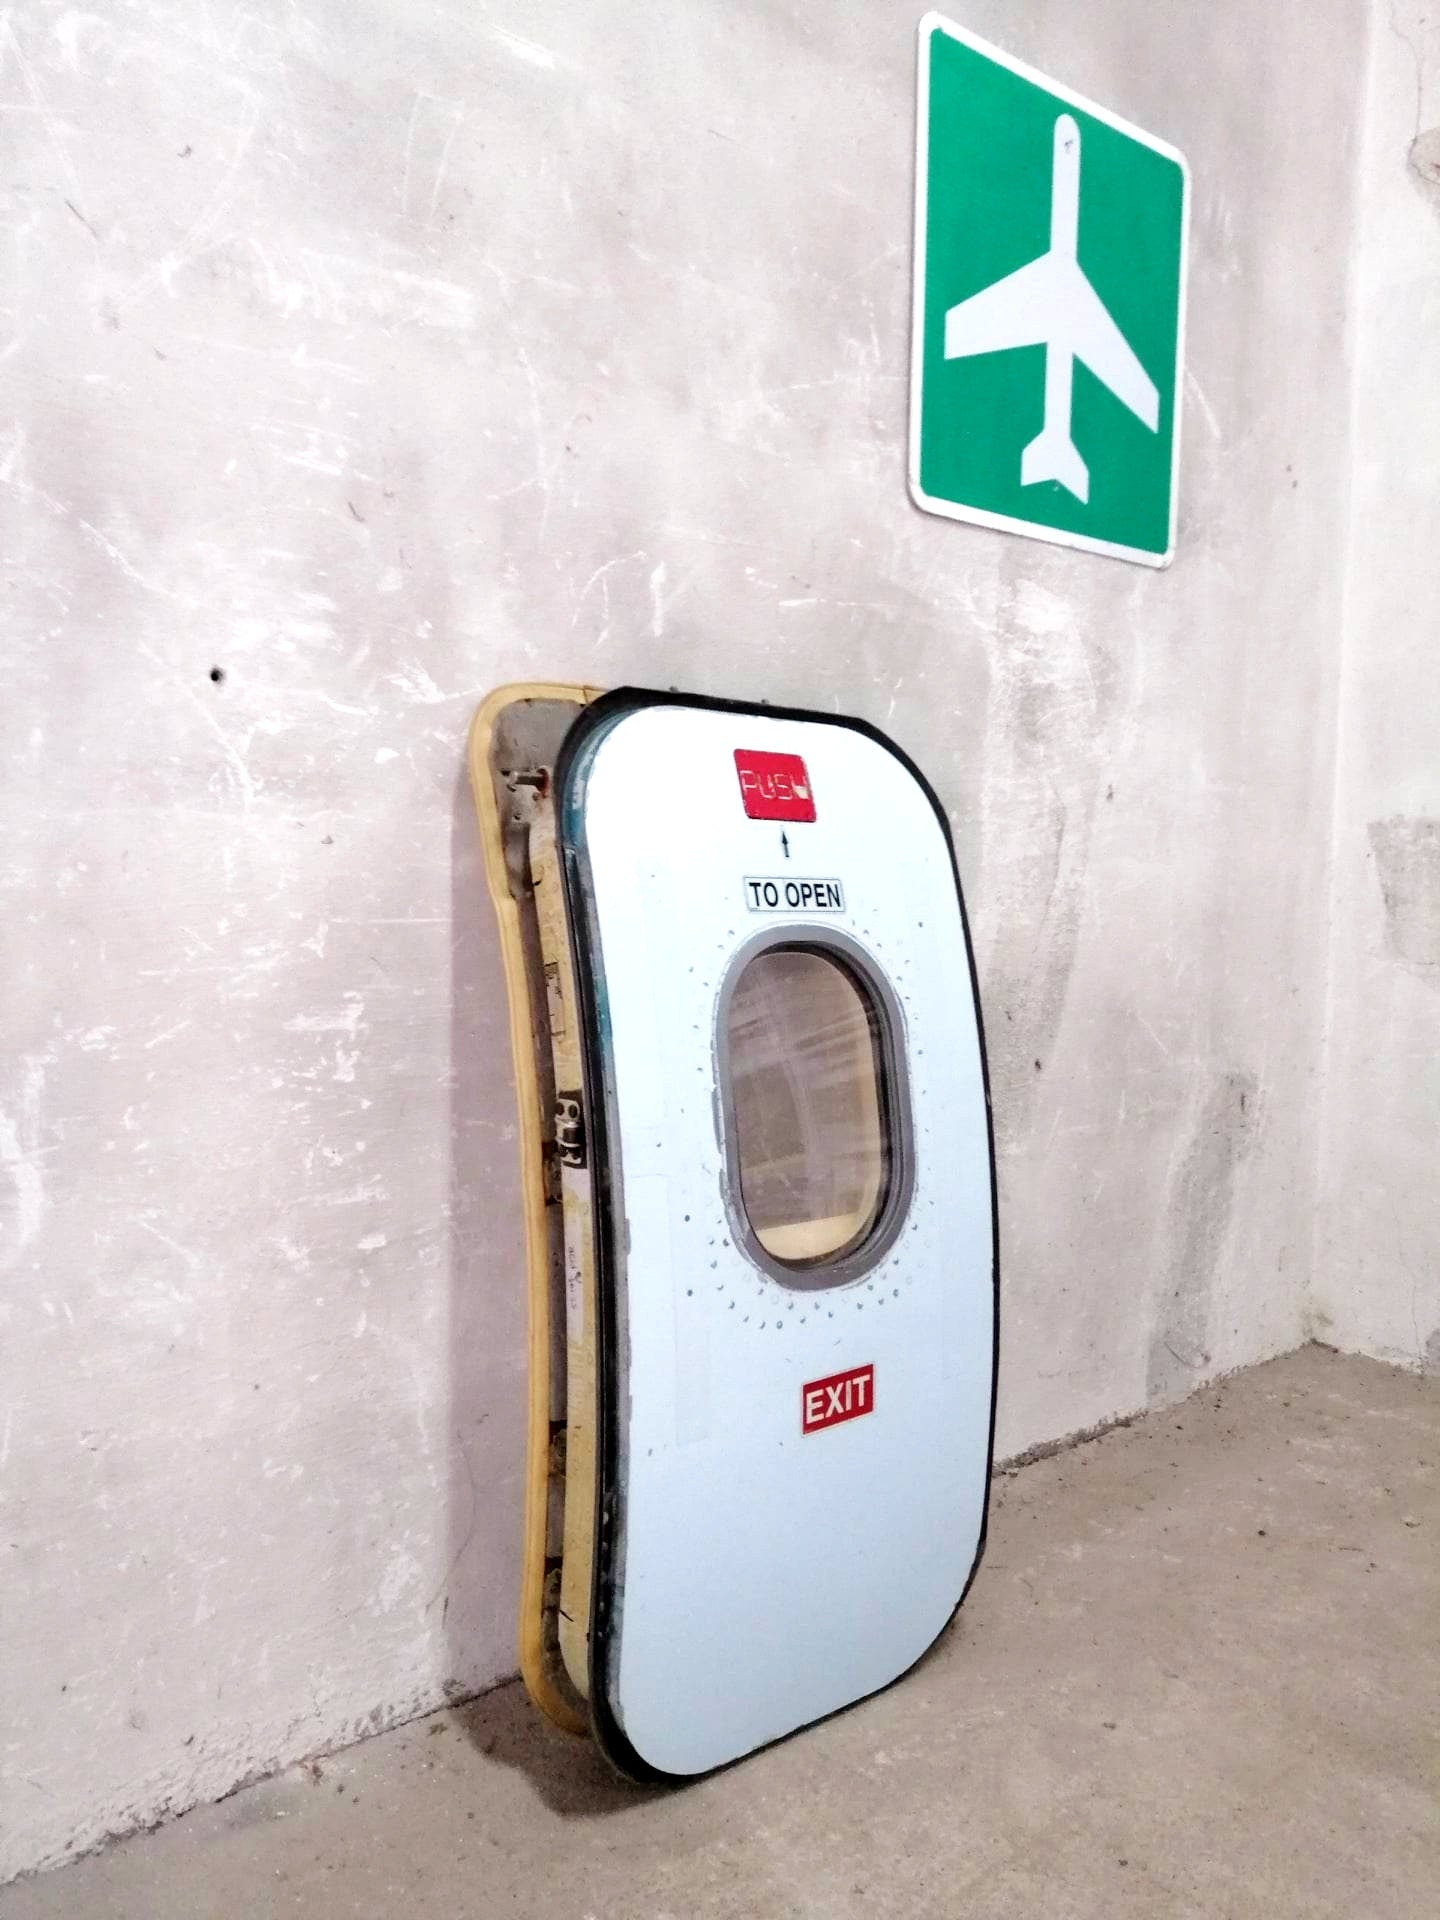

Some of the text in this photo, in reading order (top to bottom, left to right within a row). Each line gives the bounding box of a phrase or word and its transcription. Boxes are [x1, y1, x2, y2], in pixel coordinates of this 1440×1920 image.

[740, 770, 809, 800] PUSH
[749, 882, 841, 907] TO OPEN
[806, 1374, 871, 1424] EXIT
